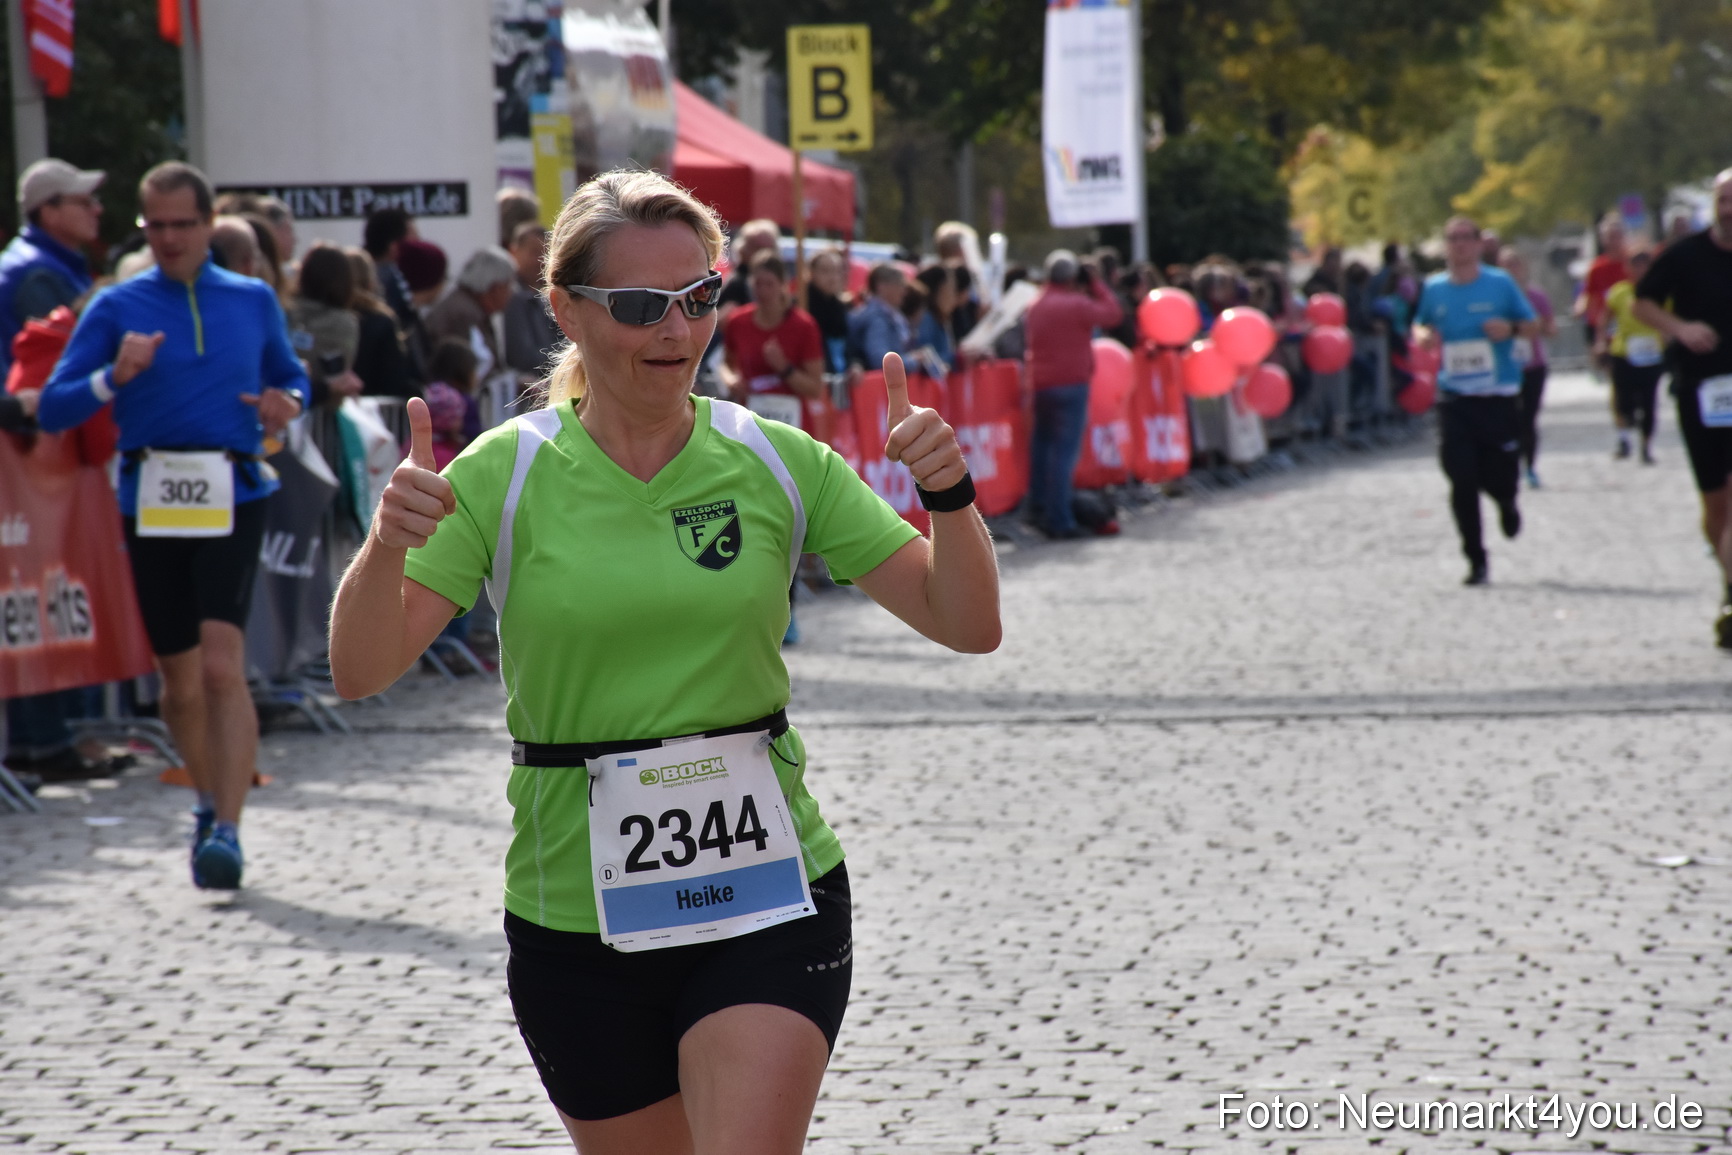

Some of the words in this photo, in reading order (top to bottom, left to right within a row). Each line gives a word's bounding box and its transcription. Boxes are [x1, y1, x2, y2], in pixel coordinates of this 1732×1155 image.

[812, 65, 849, 121] B
[1348, 189, 1372, 222] C
[160, 478, 210, 505] 302
[674, 501, 733, 518] EZELSDORF
[685, 513, 708, 523] 1923
[709, 510, 726, 519] e.V.
[690, 524, 706, 548] F
[715, 535, 735, 558] C
[660, 756, 728, 783] BOCK
[662, 780, 684, 789] inspired
[685, 778, 693, 786] by
[693, 776, 709, 784] smart
[709, 772, 730, 781] concepts
[619, 794, 769, 874] 2344
[604, 869, 613, 880] D
[675, 884, 735, 911] Heike
